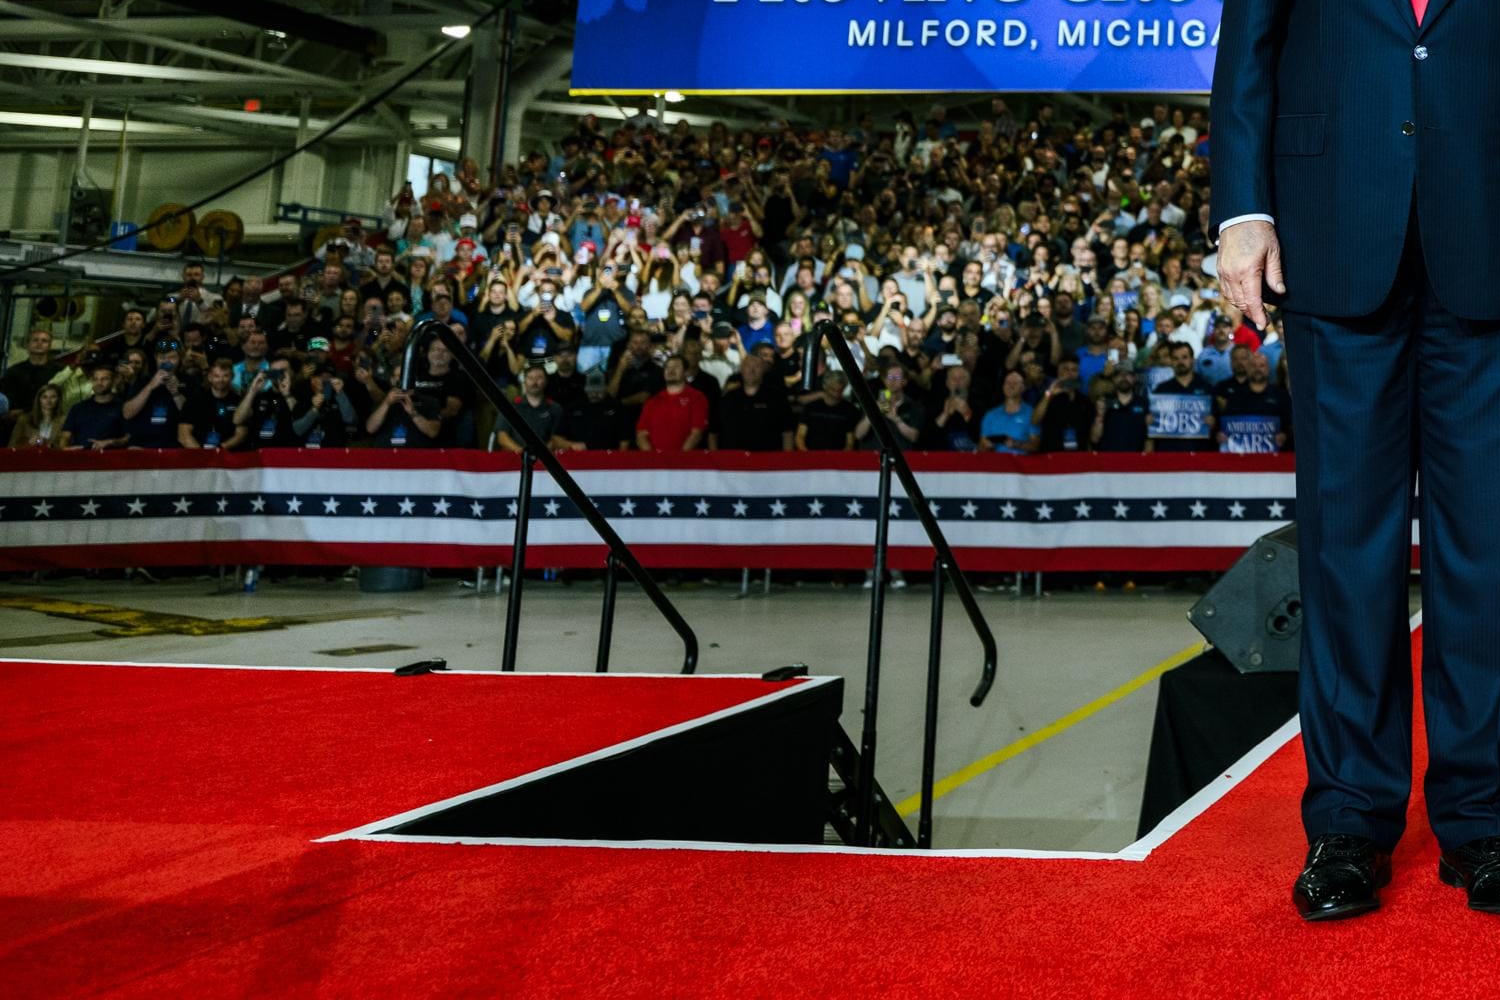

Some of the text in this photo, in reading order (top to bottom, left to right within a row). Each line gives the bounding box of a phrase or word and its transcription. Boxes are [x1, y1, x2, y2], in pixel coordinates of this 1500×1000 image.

[847, 19, 1038, 50] MILFORD,
[1155, 410, 1201, 434] JOBS
[1228, 433, 1276, 454] CARS
